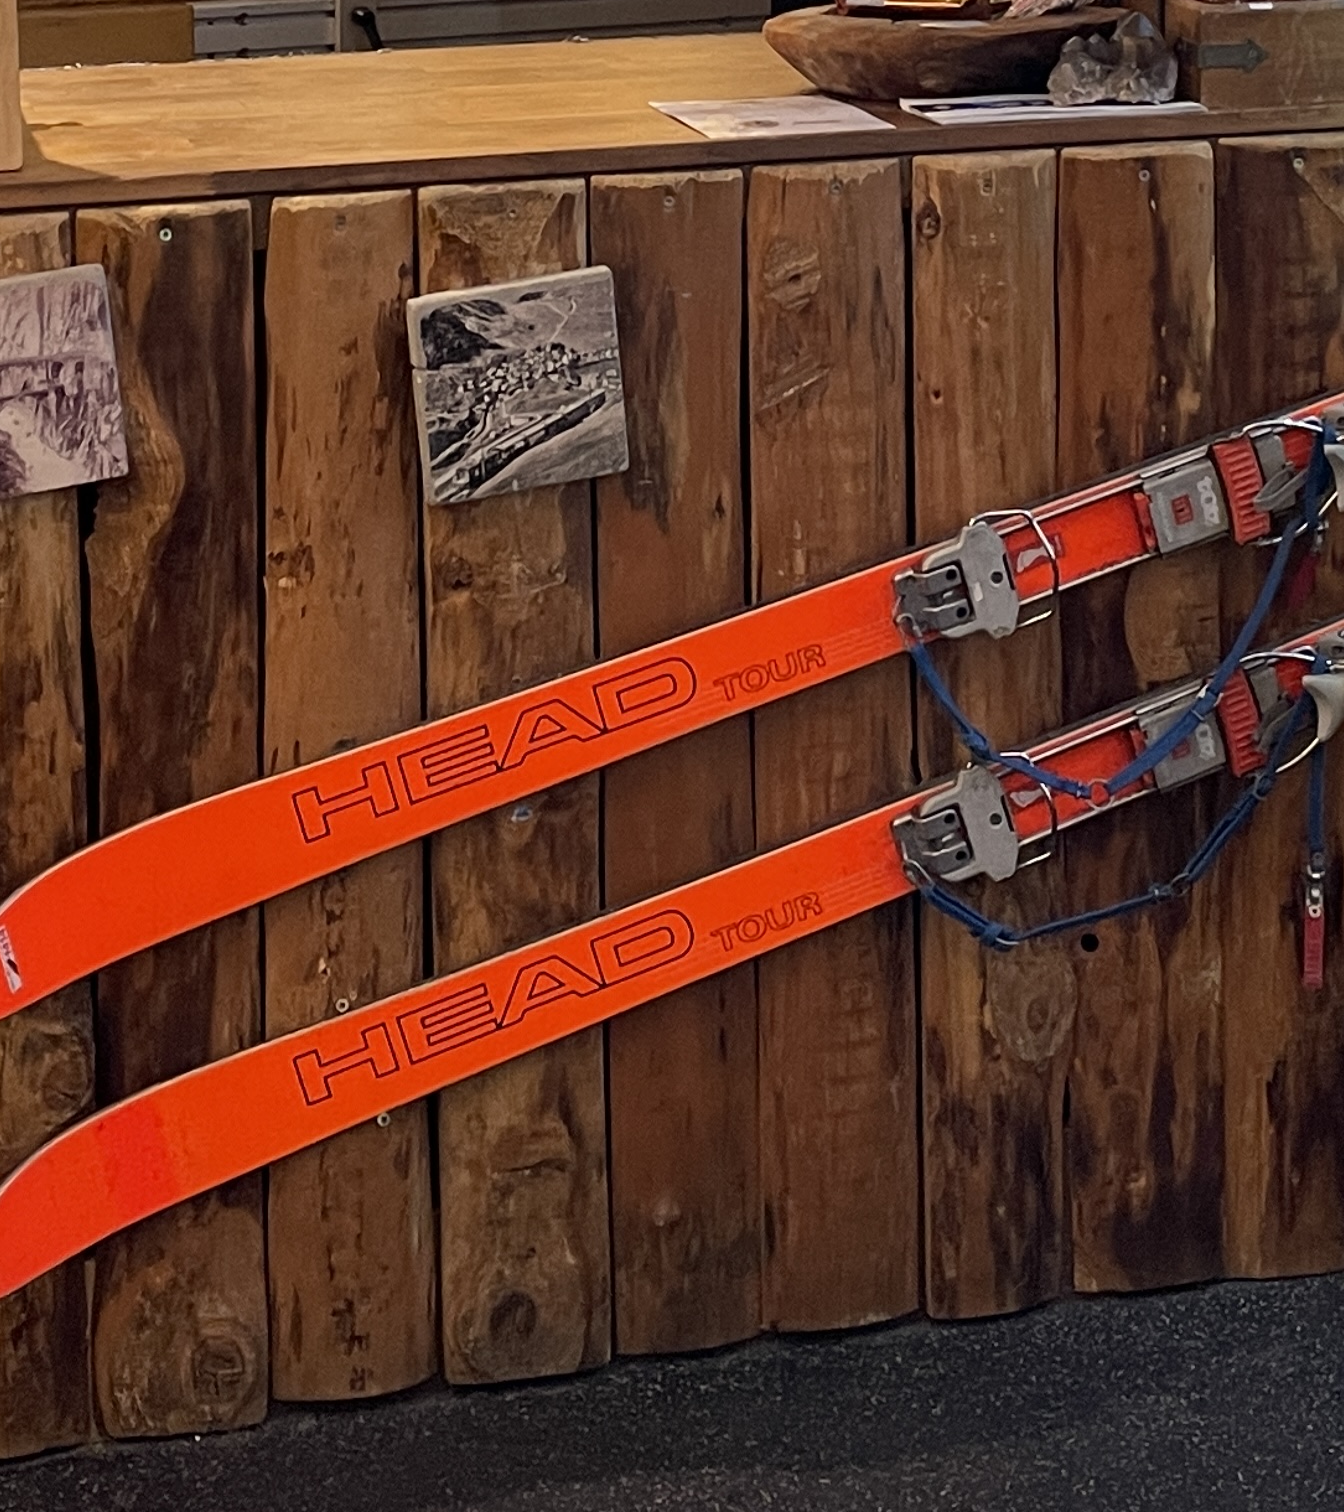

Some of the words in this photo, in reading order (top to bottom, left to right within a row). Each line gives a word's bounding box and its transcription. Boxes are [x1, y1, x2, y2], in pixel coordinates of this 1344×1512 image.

[712, 642, 827, 703] TOUR
[291, 654, 698, 845] HEAD
[709, 891, 824, 953] TOUR
[291, 907, 695, 1108] HEAD
